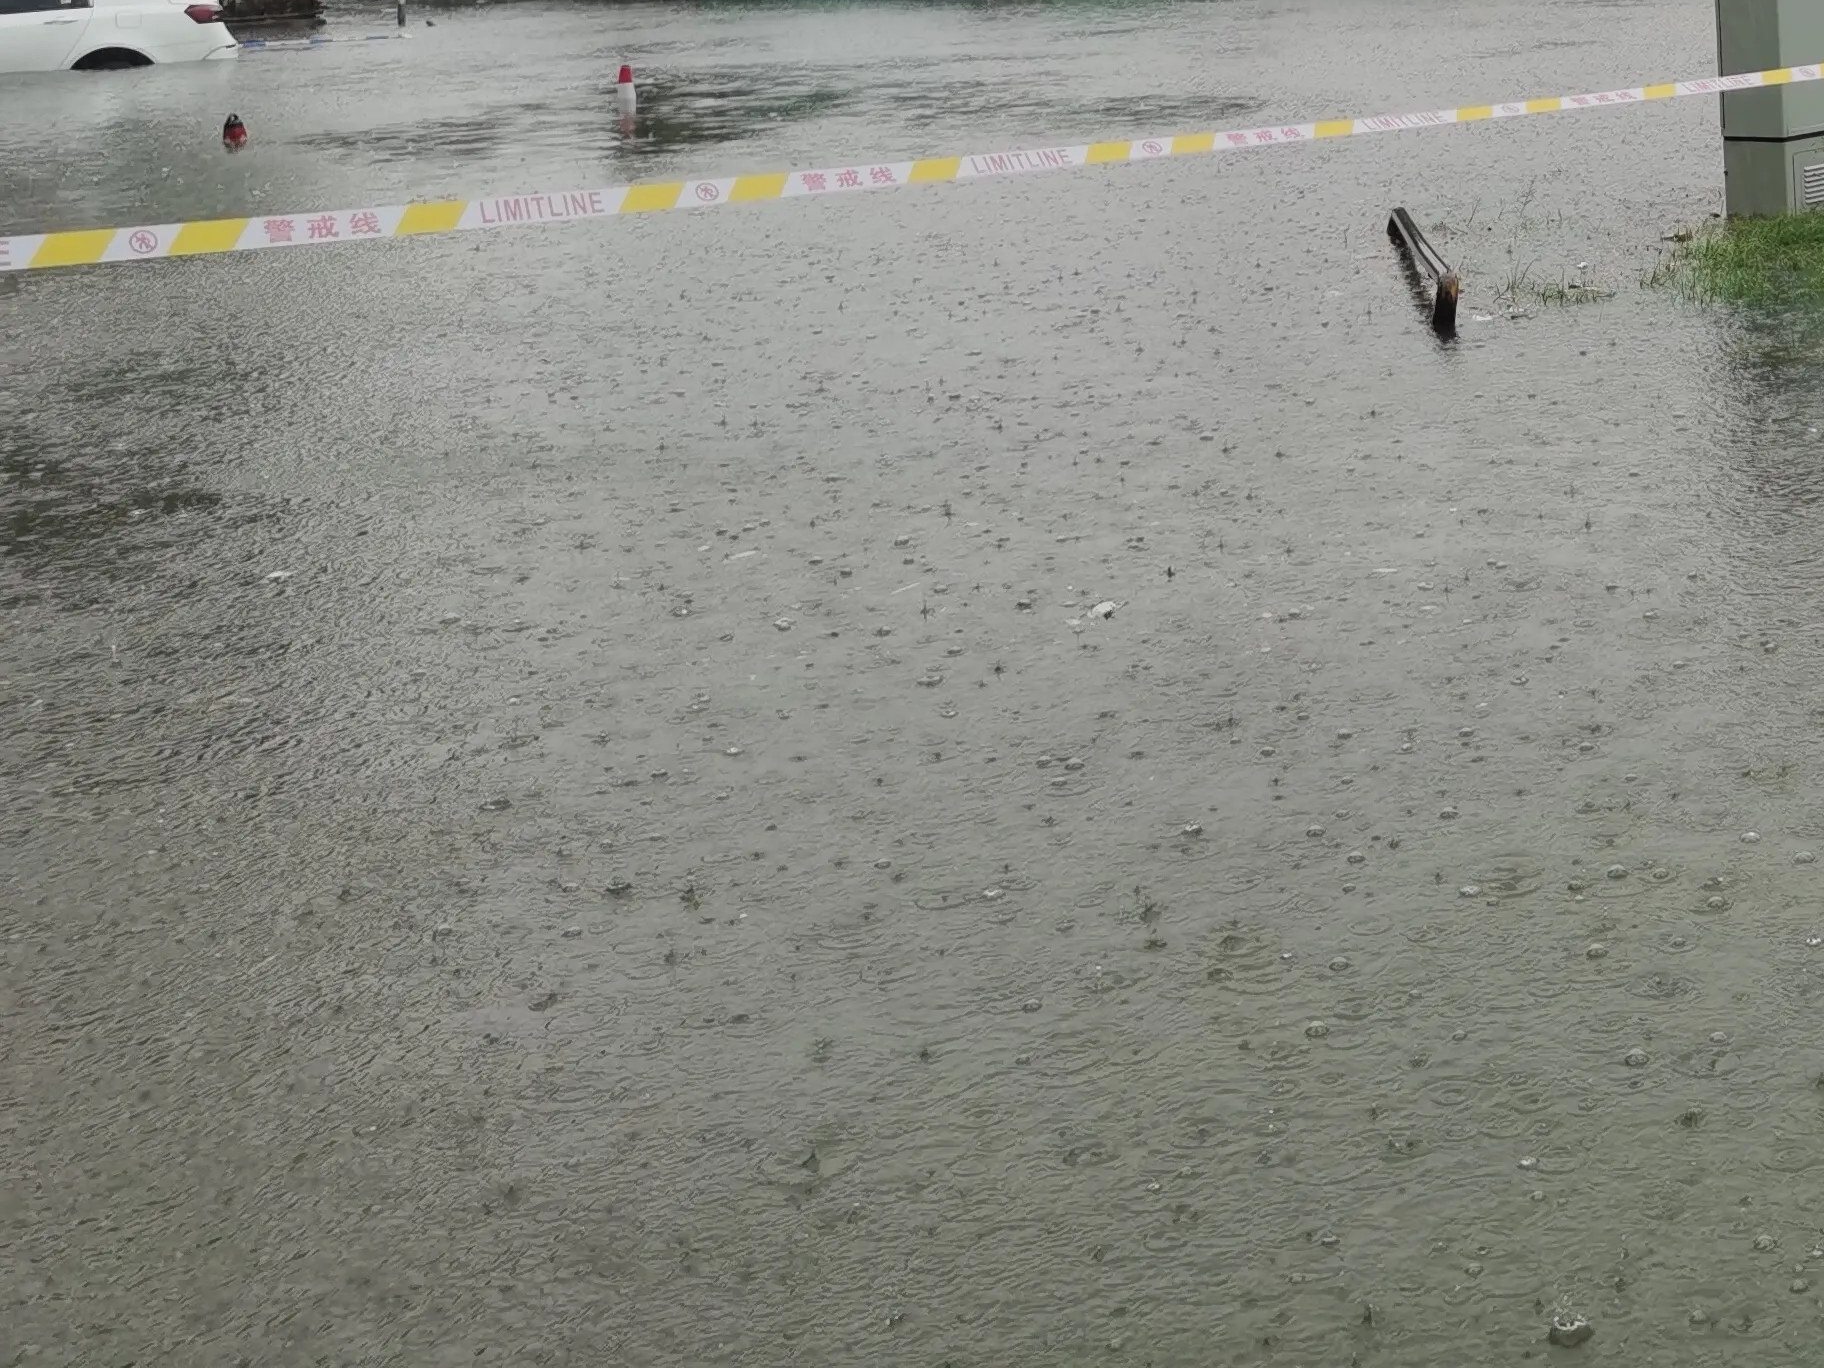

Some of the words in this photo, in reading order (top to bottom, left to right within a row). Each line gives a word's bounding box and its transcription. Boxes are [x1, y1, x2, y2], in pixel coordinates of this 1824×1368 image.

[1683, 75, 1752, 93] LIMITLINE
[1362, 111, 1444, 130] LIMITLINE
[971, 147, 1074, 175] LIMITLINE
[802, 165, 897, 192] 警戒线
[480, 190, 605, 225] LIMITLINE
[264, 211, 381, 244] 警戒线
